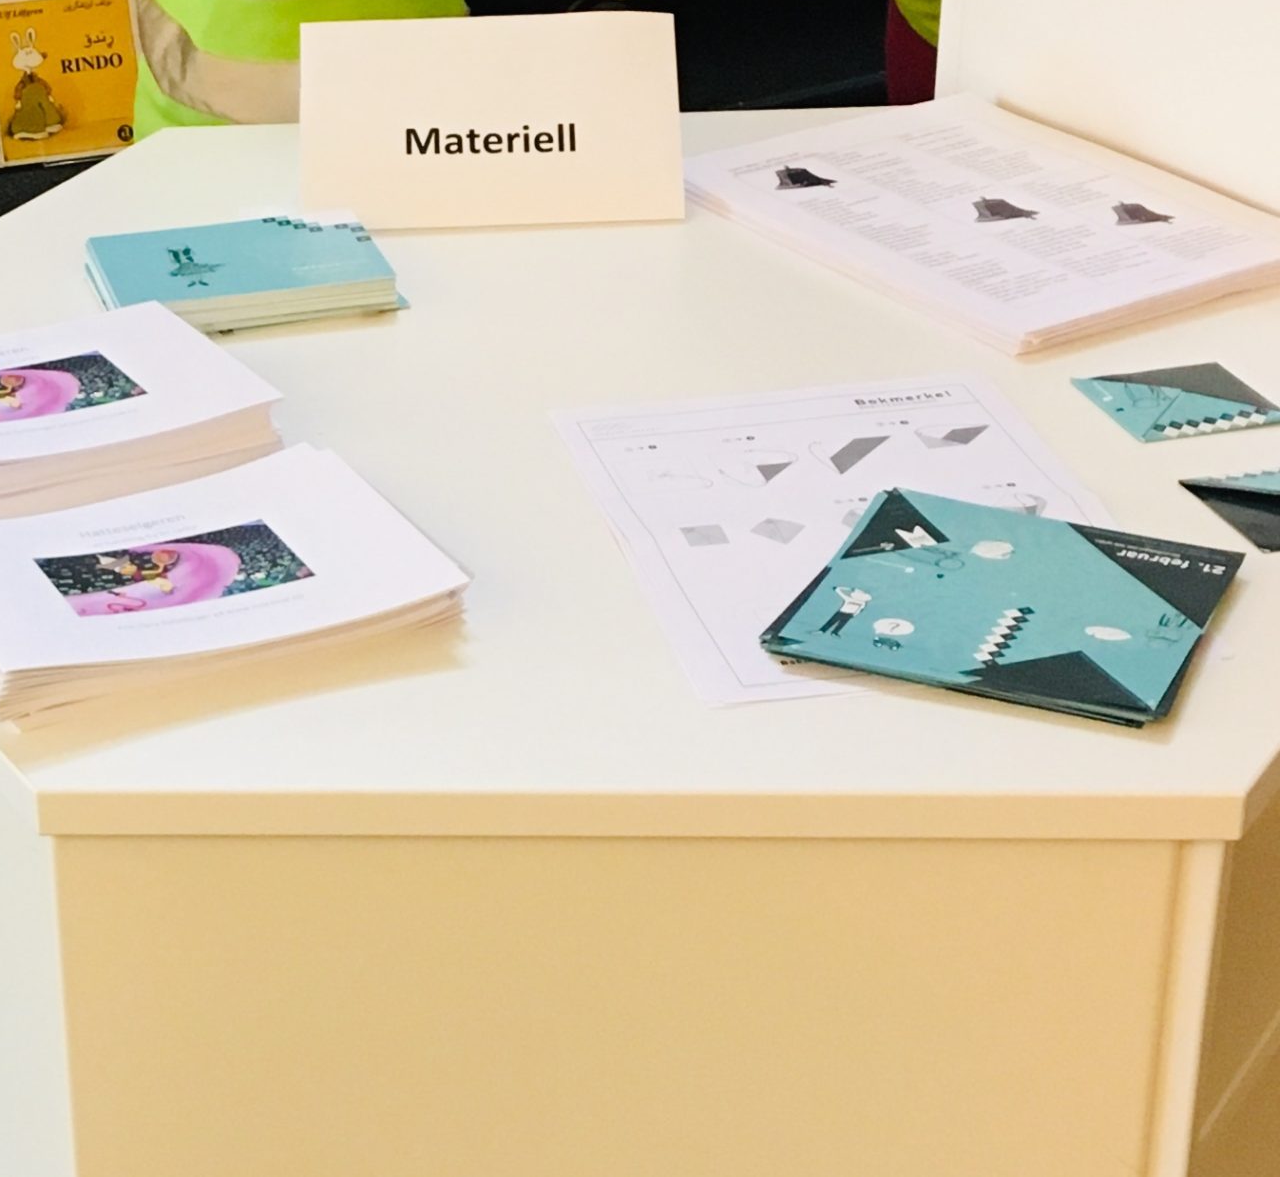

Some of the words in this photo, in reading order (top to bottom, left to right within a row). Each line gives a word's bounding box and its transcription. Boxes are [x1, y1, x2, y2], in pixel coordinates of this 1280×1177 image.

[60, 52, 124, 74] RINDO
[405, 122, 577, 155] Materiell
[1116, 549, 1191, 570] februar
[1198, 561, 1227, 576] 21.
